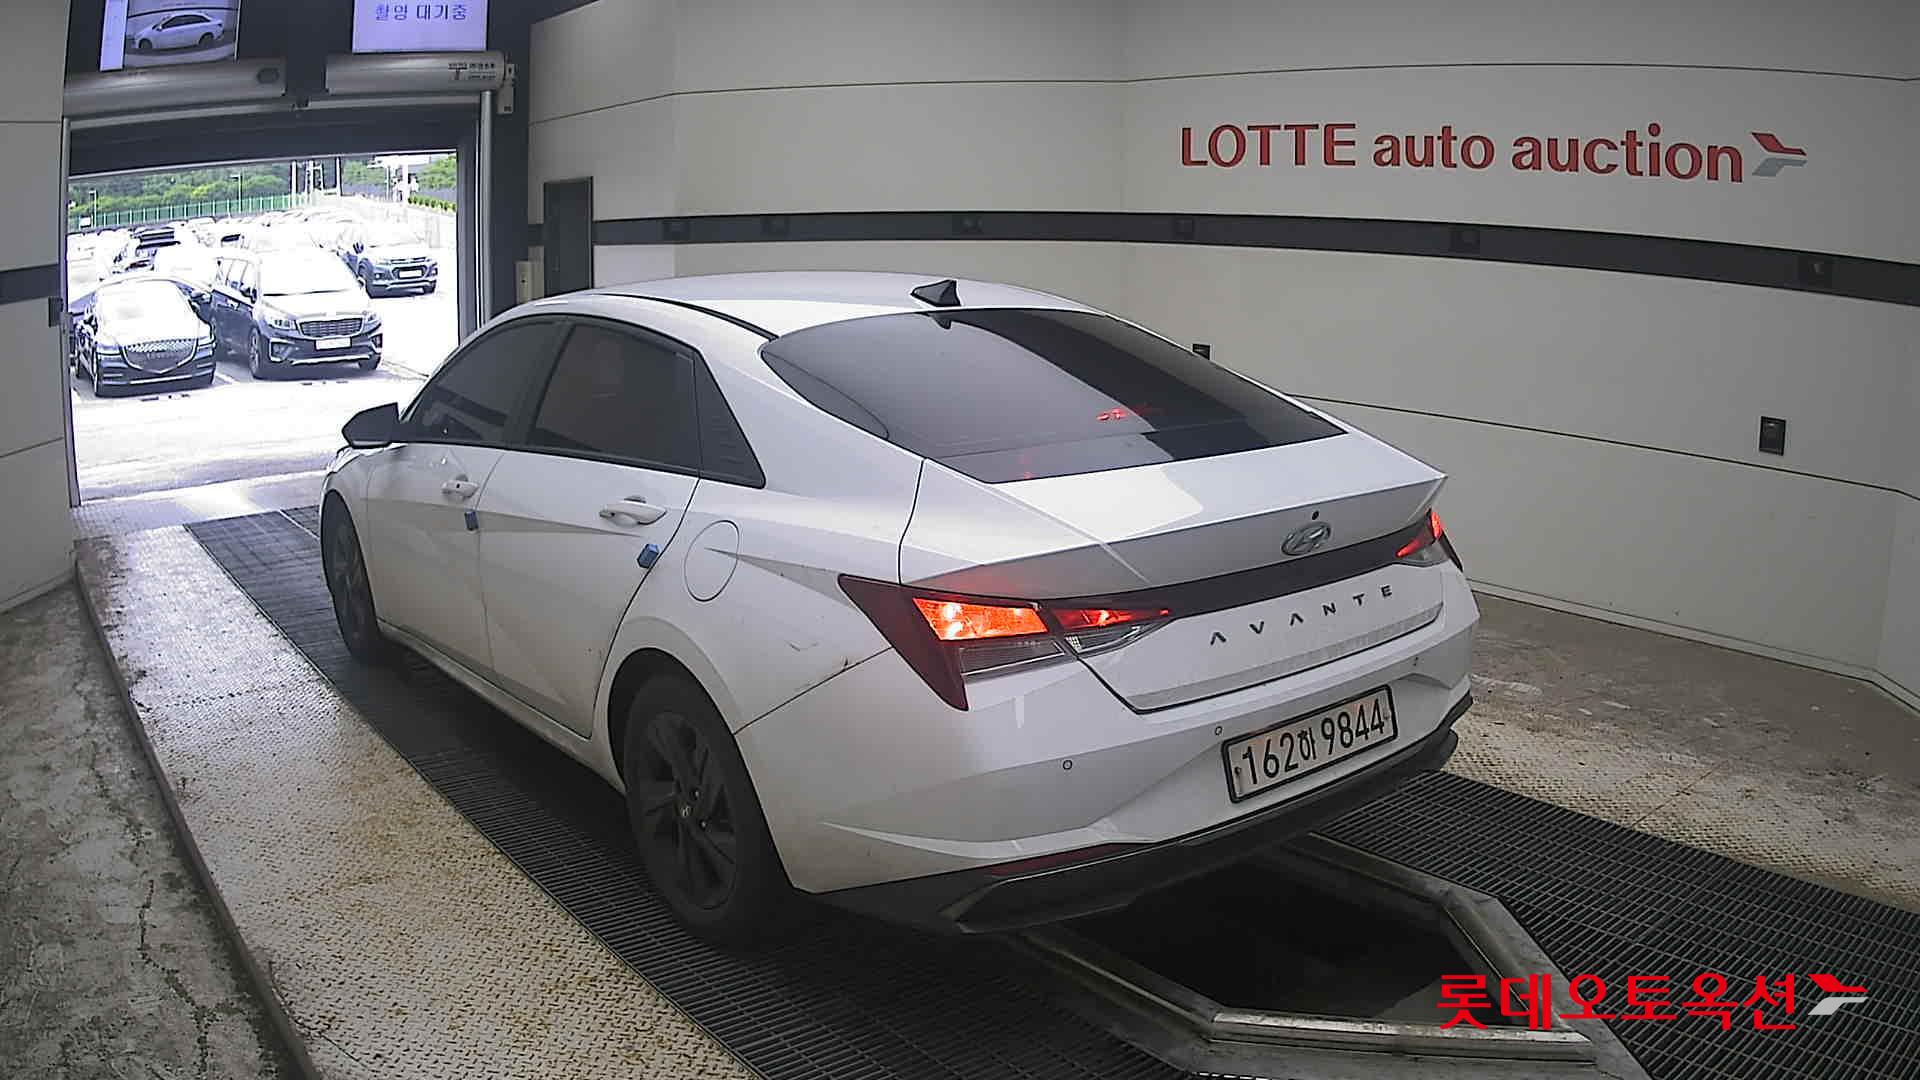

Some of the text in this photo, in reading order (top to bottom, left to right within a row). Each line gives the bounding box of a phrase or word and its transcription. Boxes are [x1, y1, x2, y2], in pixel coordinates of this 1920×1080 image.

[417, 4, 466, 20] 대기중
[1182, 123, 1742, 182] LOTTE auto auction
[1210, 585, 1393, 646] AVANTE
